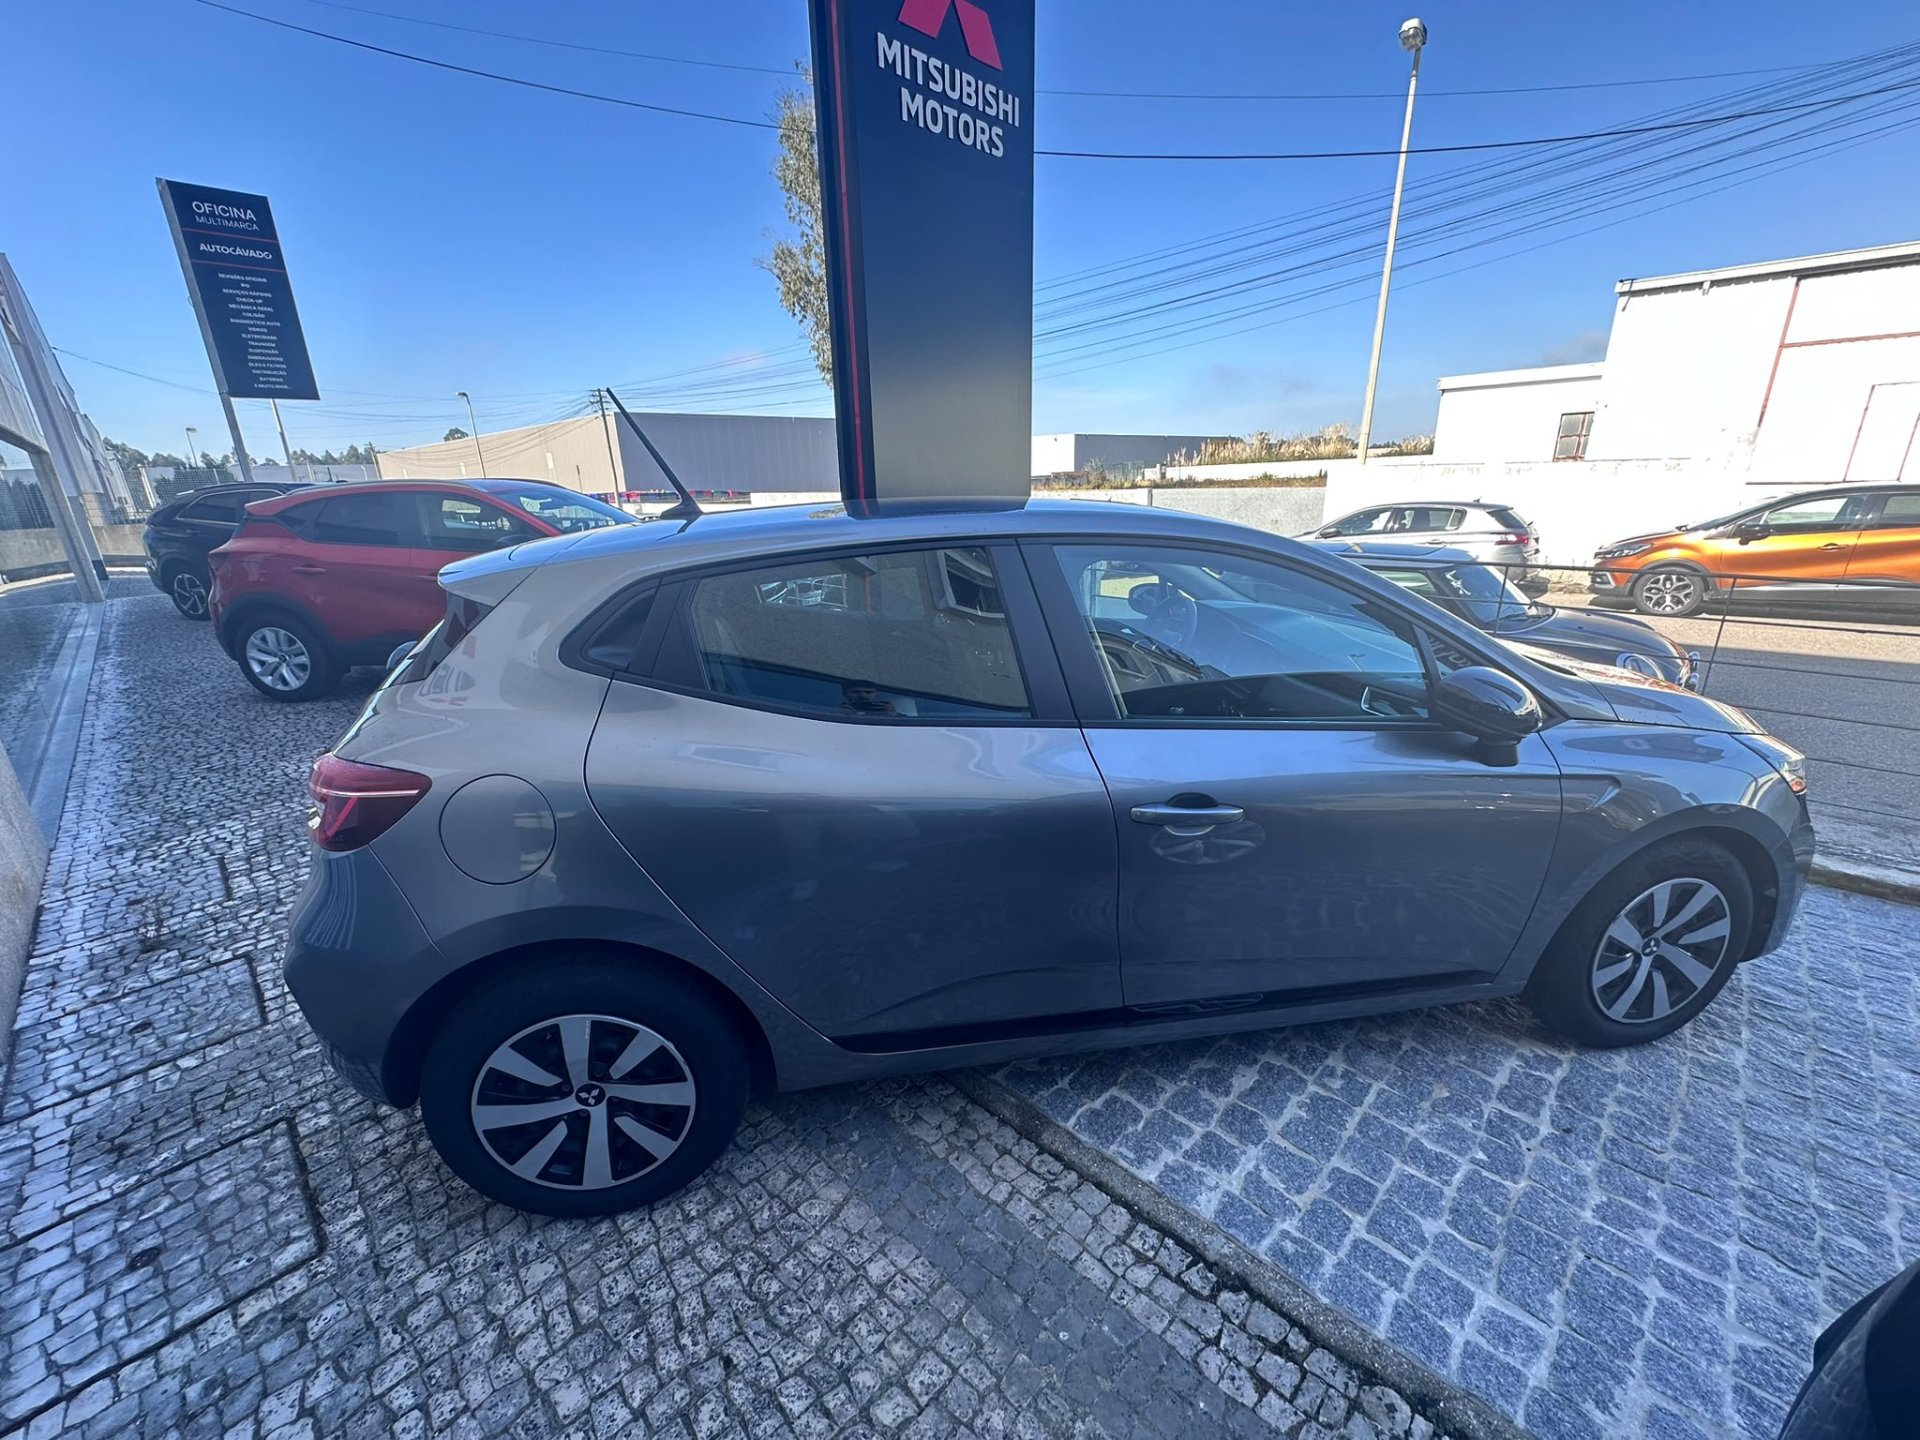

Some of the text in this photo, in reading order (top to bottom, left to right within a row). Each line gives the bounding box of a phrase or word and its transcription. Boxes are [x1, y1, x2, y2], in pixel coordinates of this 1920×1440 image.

[876, 32, 1020, 128] MITSUBISHI
[900, 87, 1004, 158] MOTORS
[192, 201, 257, 222] OFICINA
[195, 215, 259, 231] MULTIMARCA
[199, 243, 272, 260] AUTOCÁVADO
[218, 273, 244, 281] REVISÕES
[222, 288, 272, 298] SERVIÇOS RÁPIDOS
[236, 296, 263, 304] CHECK-UP
[230, 318, 266, 326] DIAGNÓSTICO
